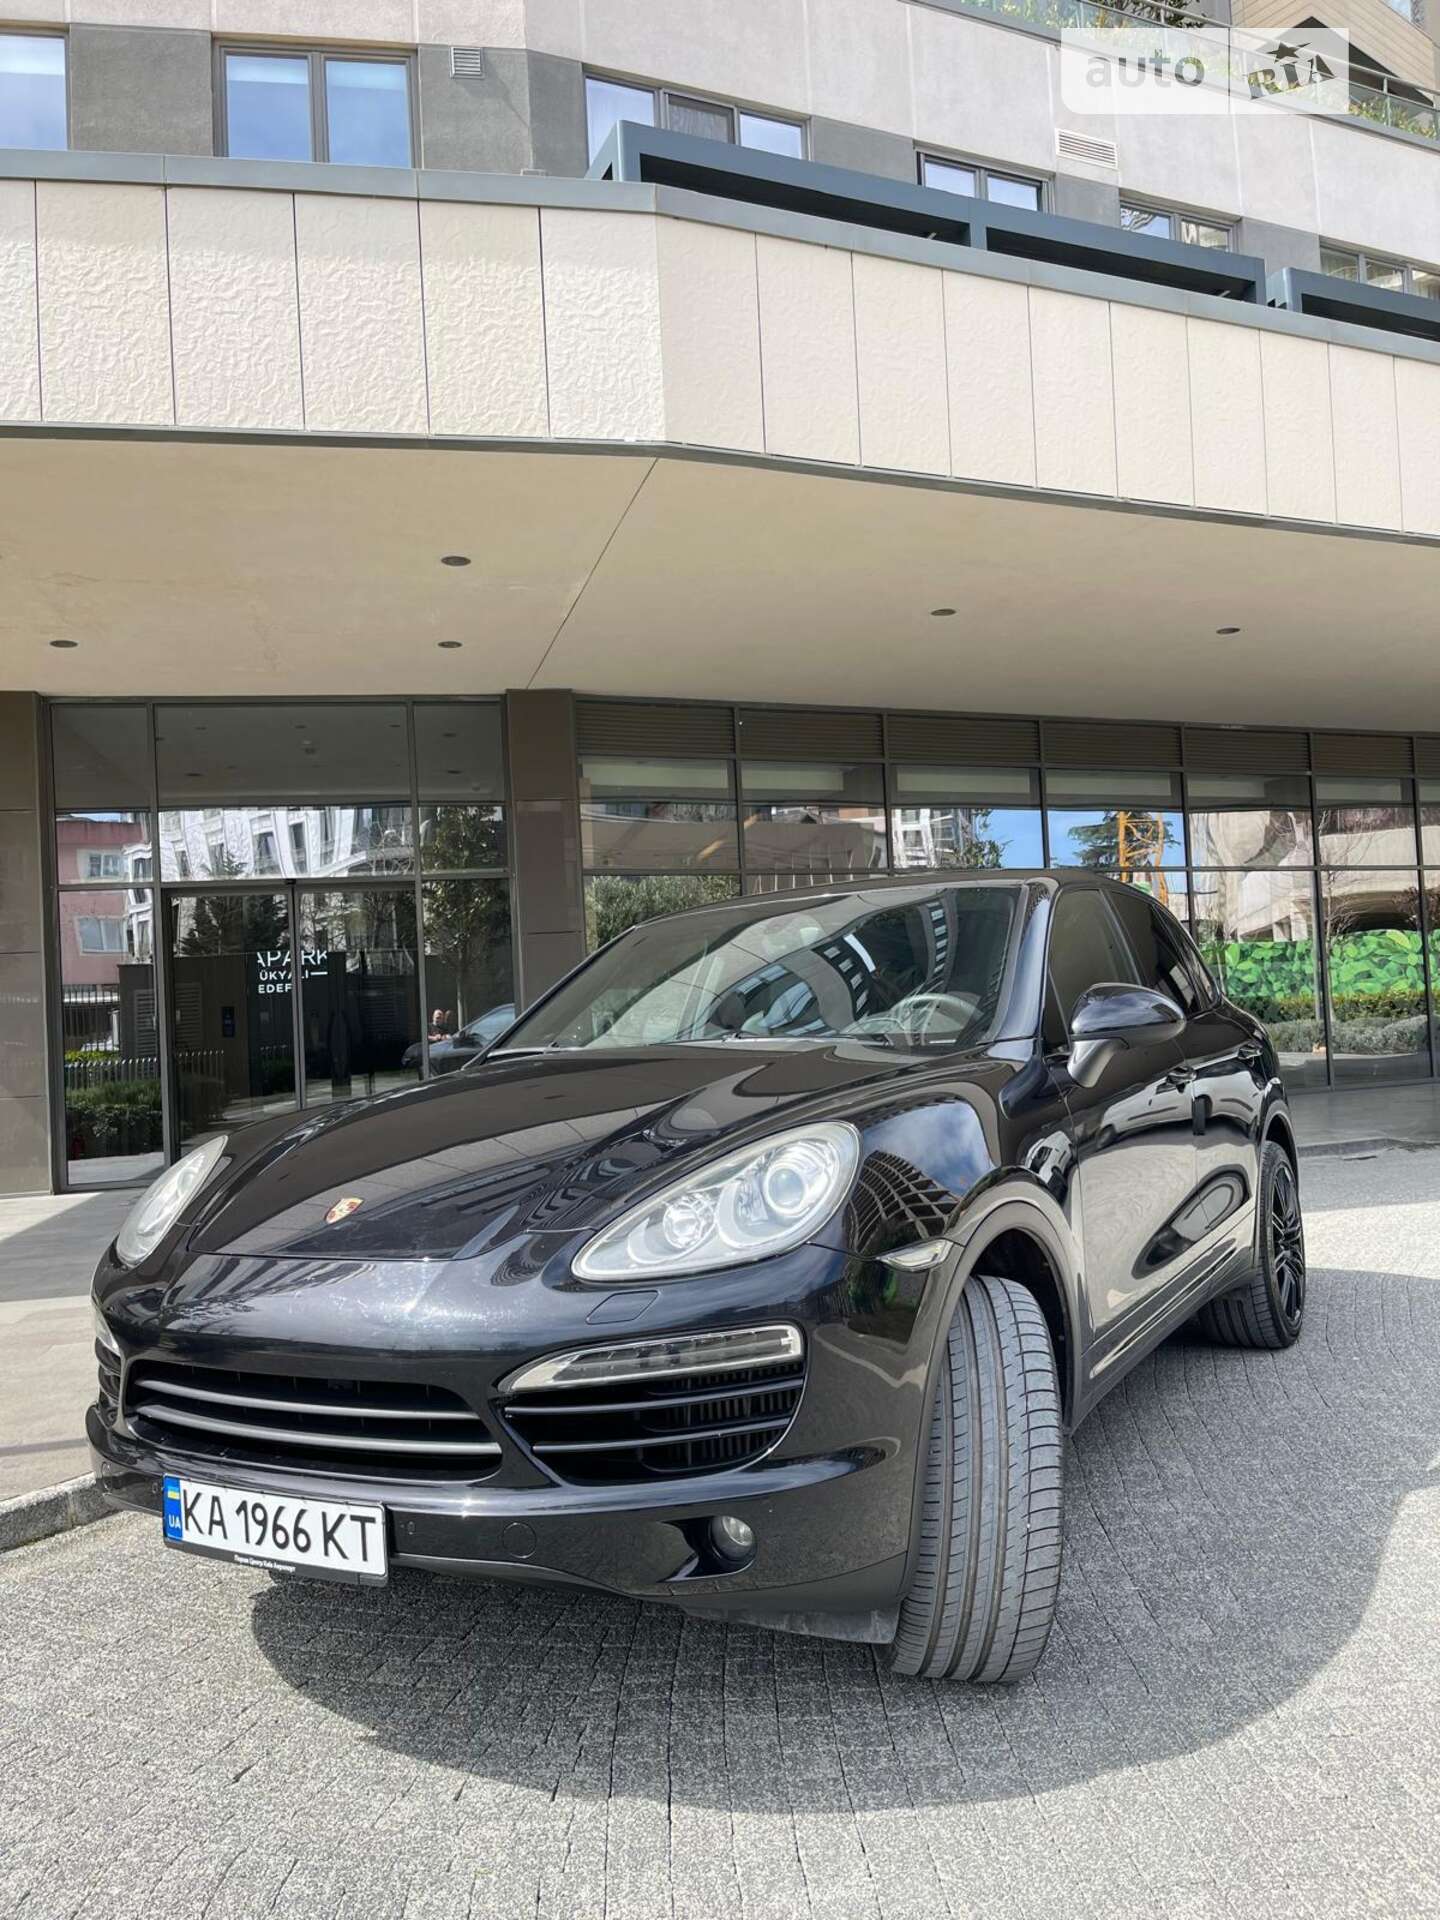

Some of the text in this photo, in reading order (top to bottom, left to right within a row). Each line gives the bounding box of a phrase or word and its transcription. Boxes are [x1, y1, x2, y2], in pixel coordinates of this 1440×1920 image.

[168, 1514, 181, 1529] UA
[183, 1489, 376, 1562] KA 1966 KT
